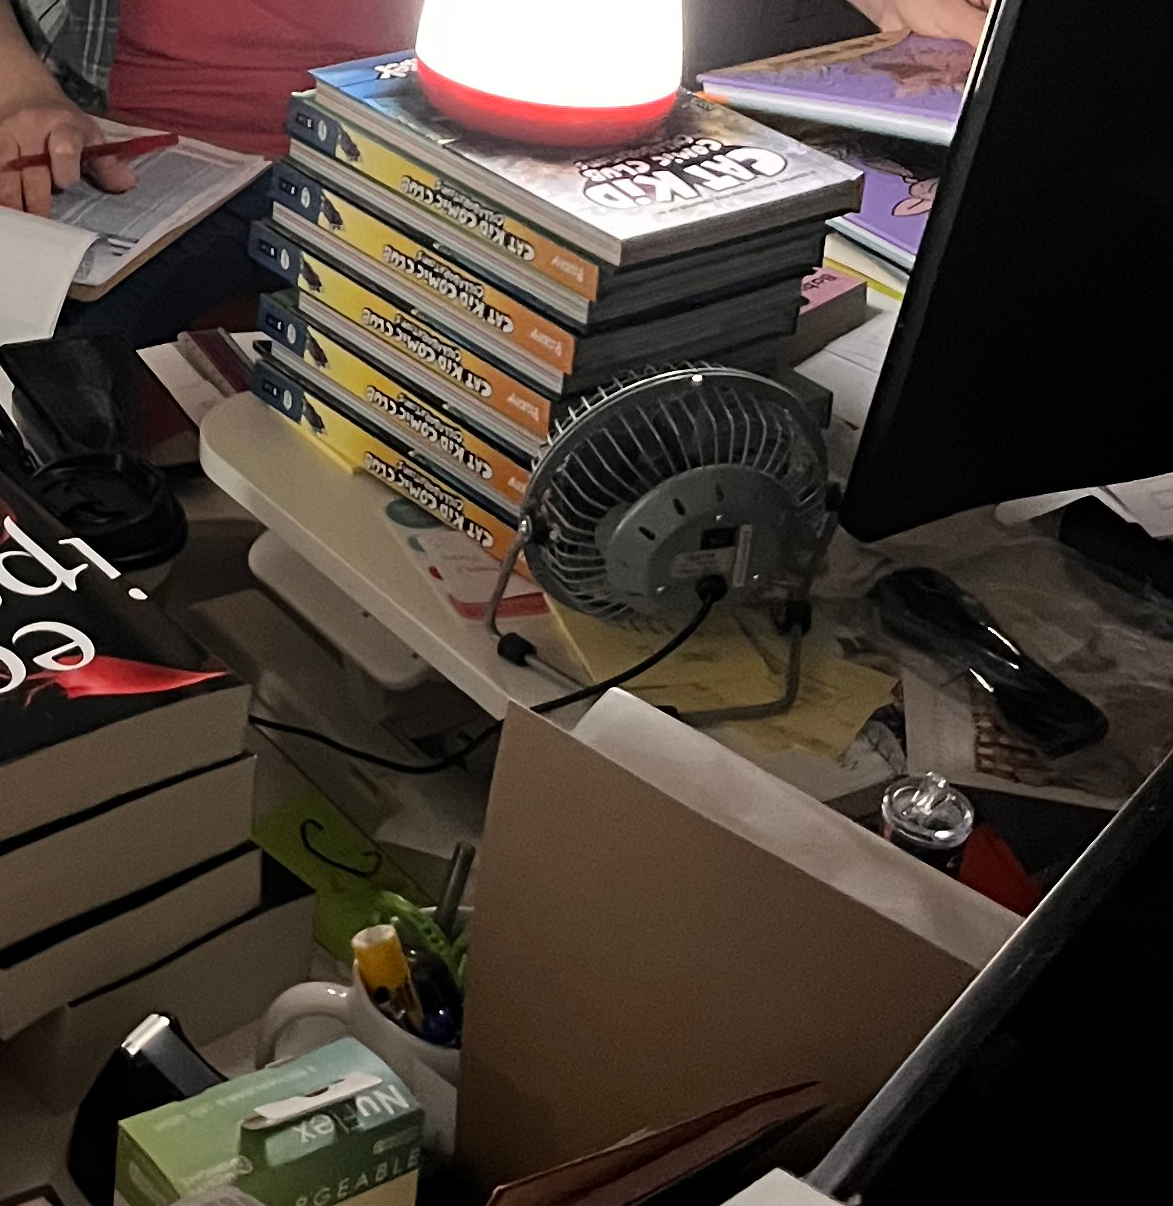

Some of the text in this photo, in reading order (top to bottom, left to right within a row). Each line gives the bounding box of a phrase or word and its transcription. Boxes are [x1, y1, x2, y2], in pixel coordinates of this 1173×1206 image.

[582, 157, 652, 182] CLUB
[681, 146, 788, 194] CAT
[508, 236, 535, 261] CAT
[487, 308, 515, 333] CAT
[466, 374, 492, 397] CAT
[466, 455, 493, 479] CAT
[466, 522, 494, 547] CAT
